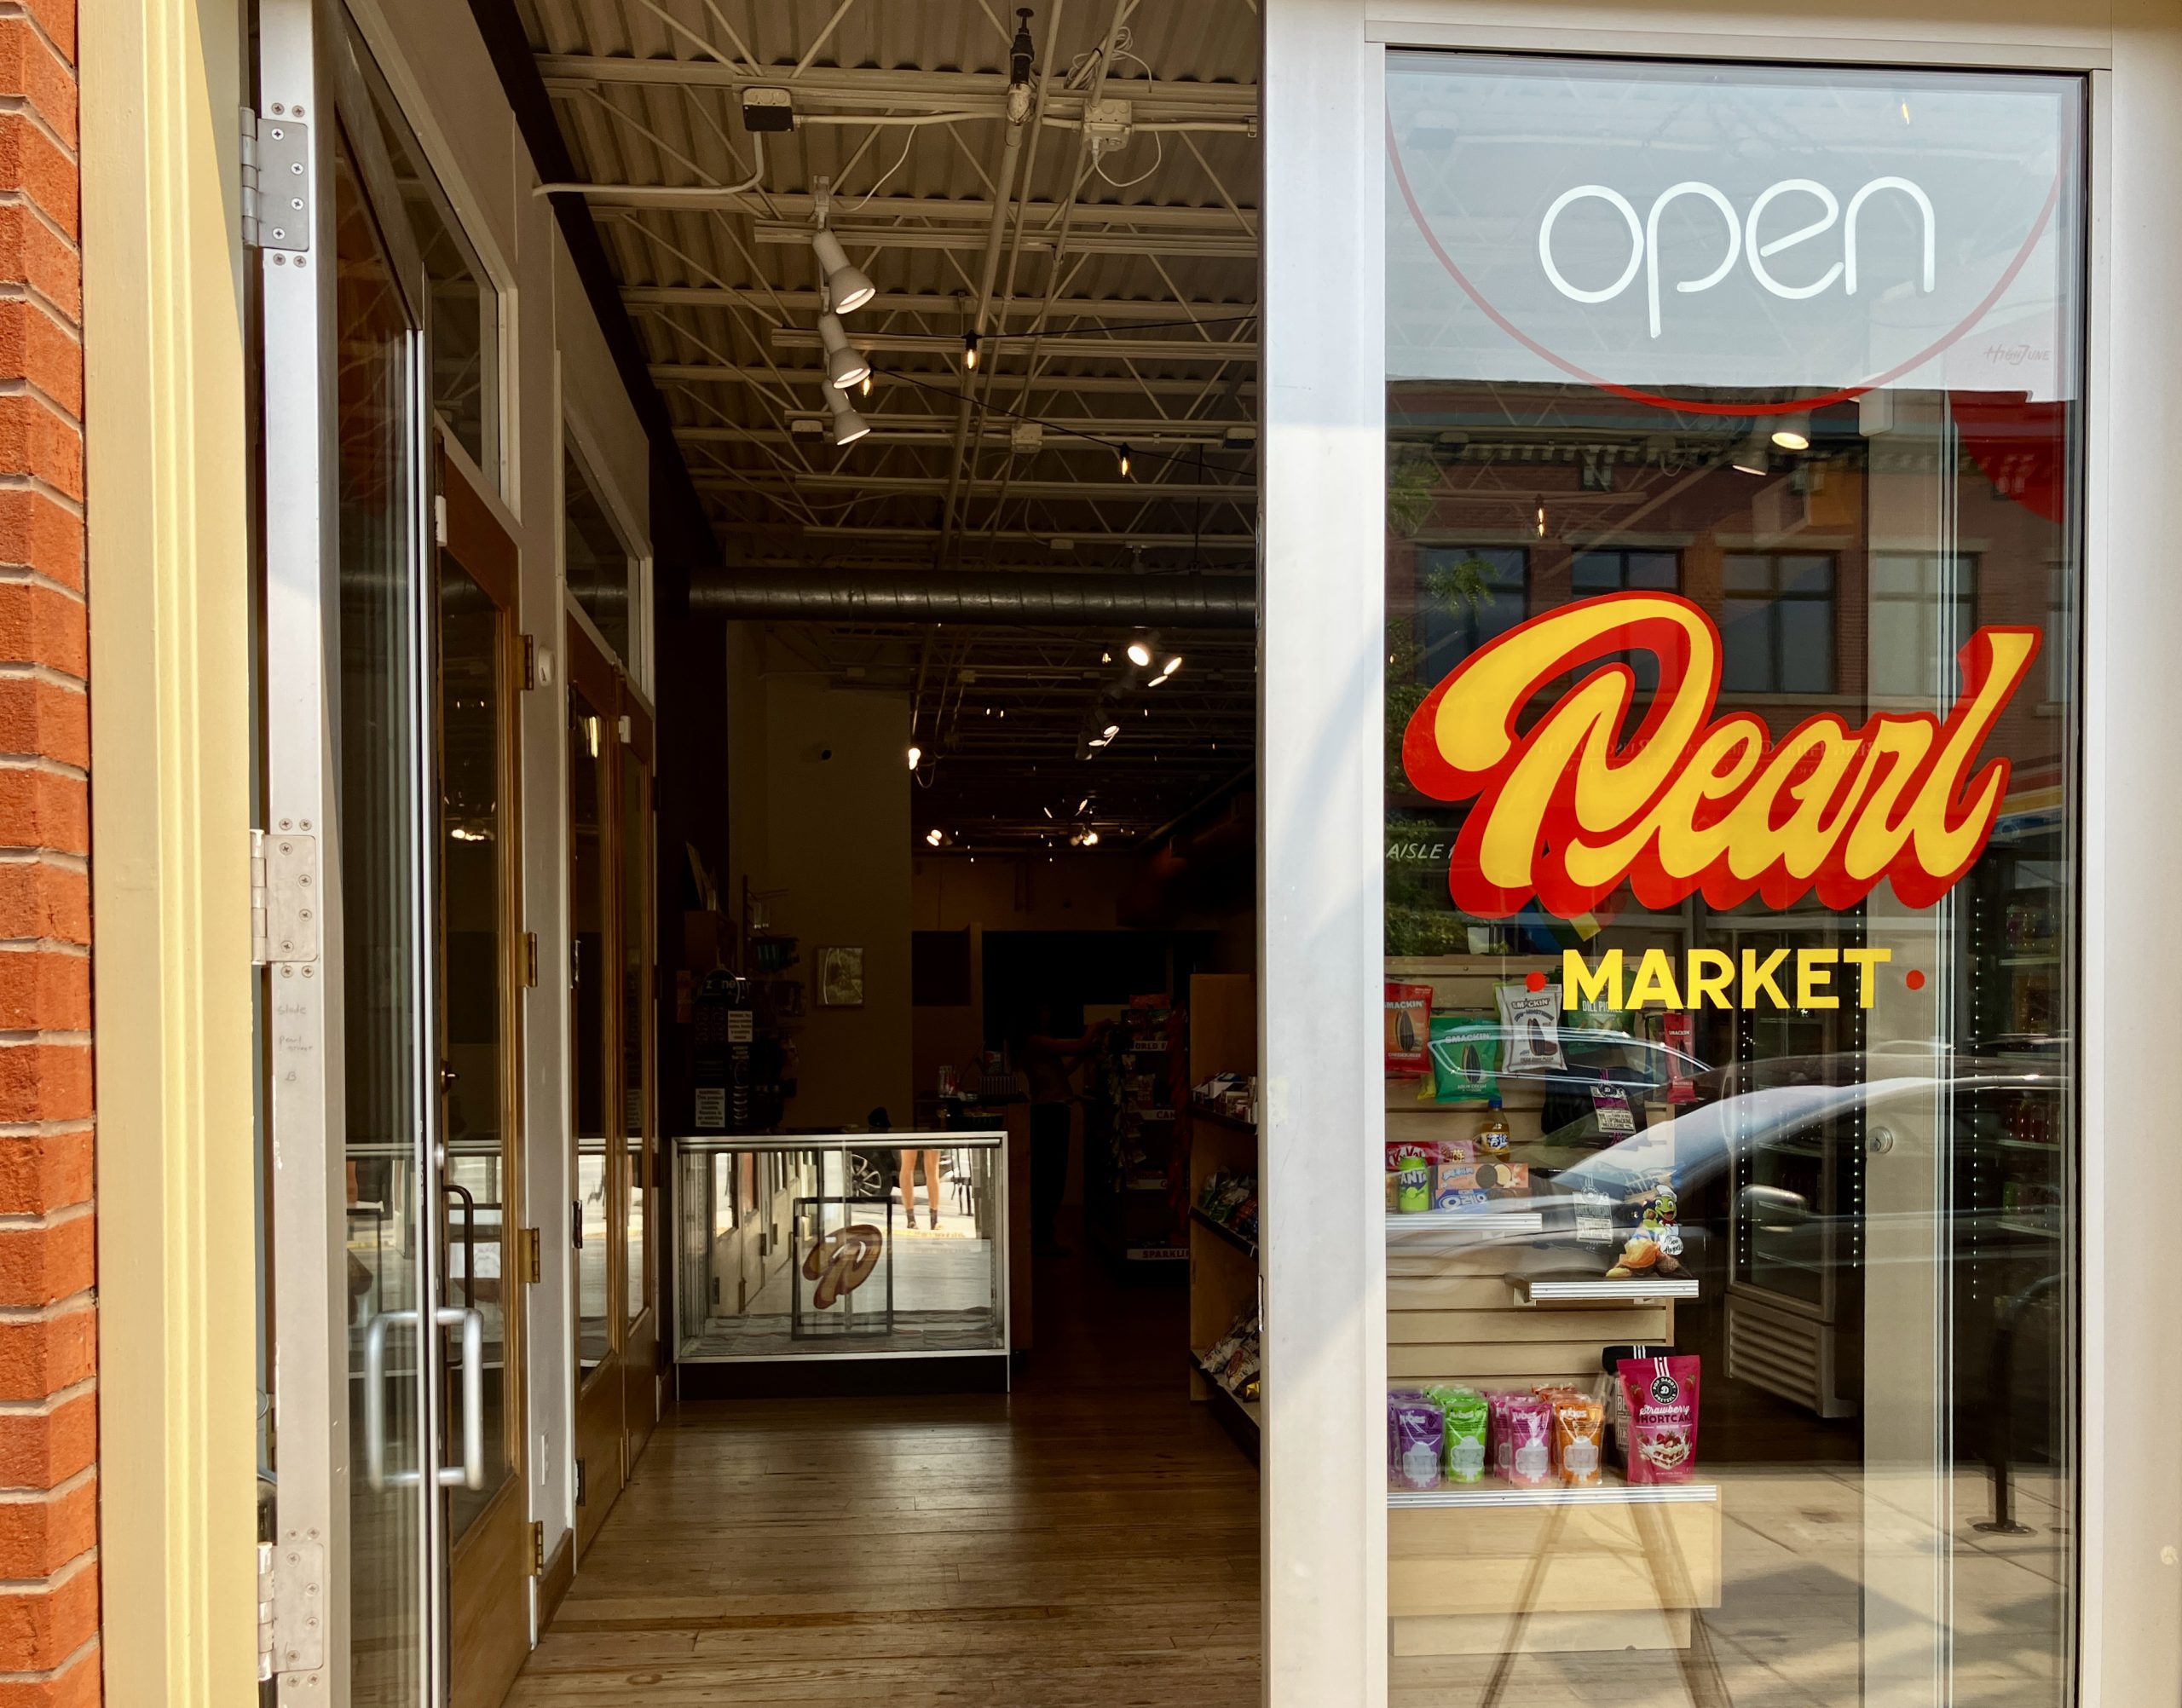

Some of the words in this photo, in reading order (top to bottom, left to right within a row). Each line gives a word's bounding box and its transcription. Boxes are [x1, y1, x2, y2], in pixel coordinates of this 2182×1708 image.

[1538, 176, 1936, 338] open
[1405, 590, 2042, 918] Pearl
[1386, 843, 1444, 861] AISLE
[1563, 949, 1891, 1009] MARKET
